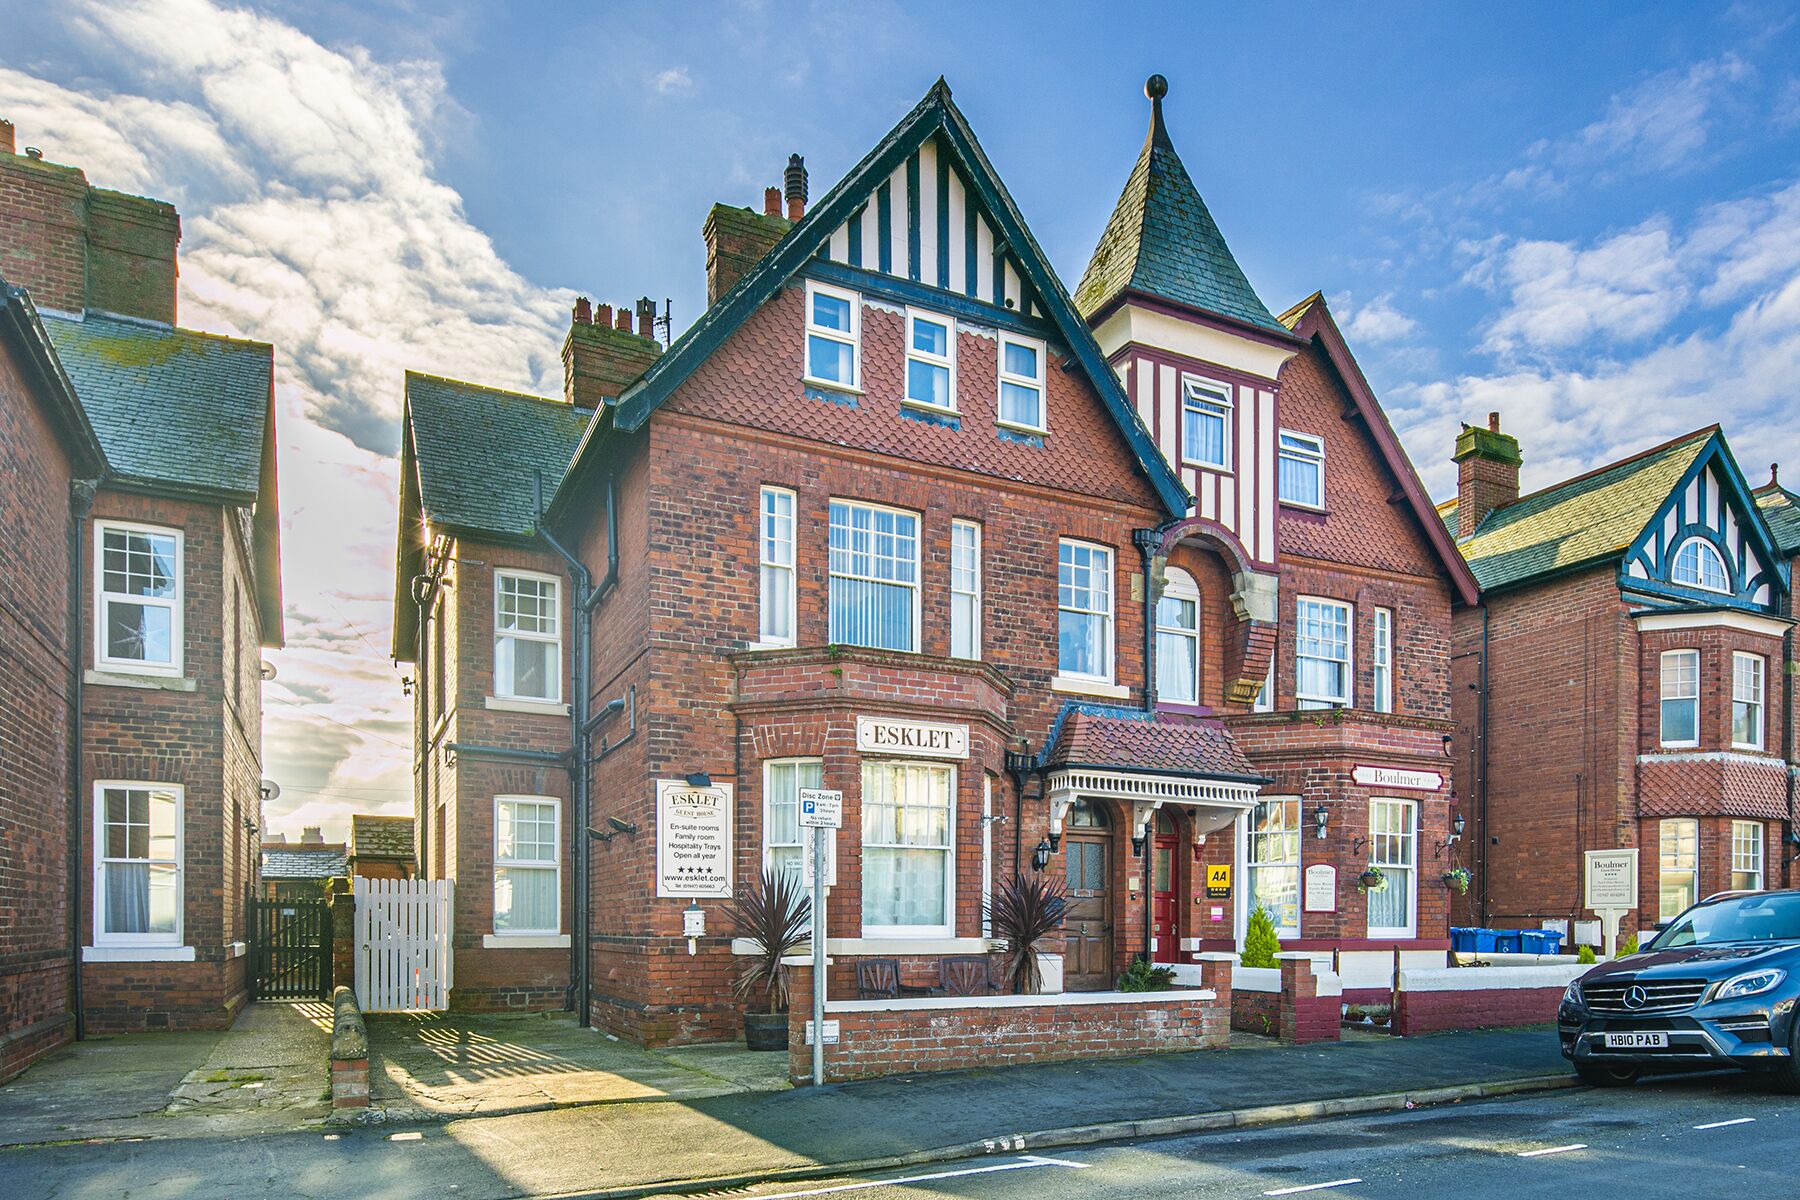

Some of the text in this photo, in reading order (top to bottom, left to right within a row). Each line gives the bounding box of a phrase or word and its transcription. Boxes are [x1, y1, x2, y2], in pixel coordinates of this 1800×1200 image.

[874, 726, 953, 749] ESKLET
[1374, 770, 1421, 785] Boulmer
[672, 794, 719, 806] ESKLET
[675, 833, 696, 841] Family
[669, 842, 721, 851] Hospitality Trays
[1212, 871, 1226, 881] AA
[1611, 1035, 1660, 1045] HB10 PAB
